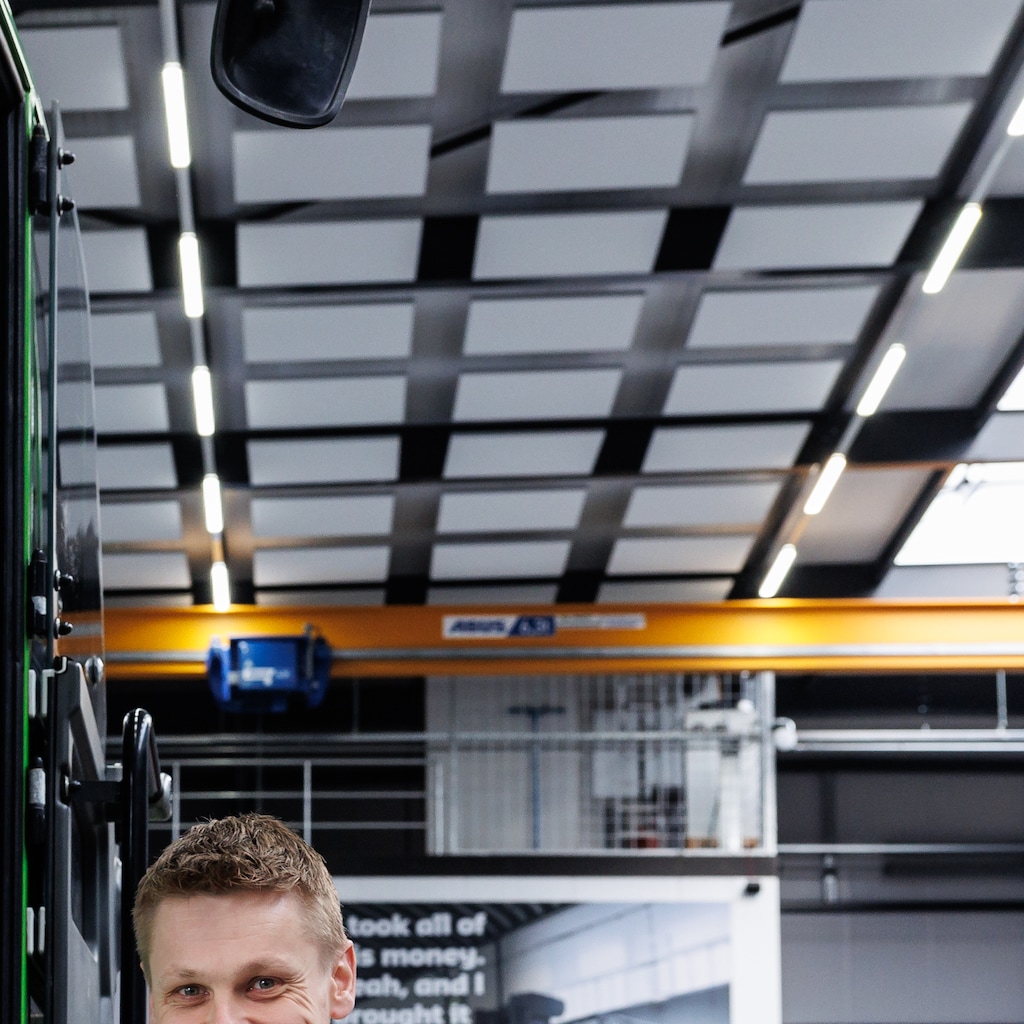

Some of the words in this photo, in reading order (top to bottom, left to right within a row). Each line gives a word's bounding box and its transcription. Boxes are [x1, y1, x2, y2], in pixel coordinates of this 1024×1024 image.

[347, 913, 411, 937] took
[415, 912, 452, 937] all
[456, 911, 487, 937] of
[380, 947, 486, 970] money.
[414, 972, 469, 996] and
